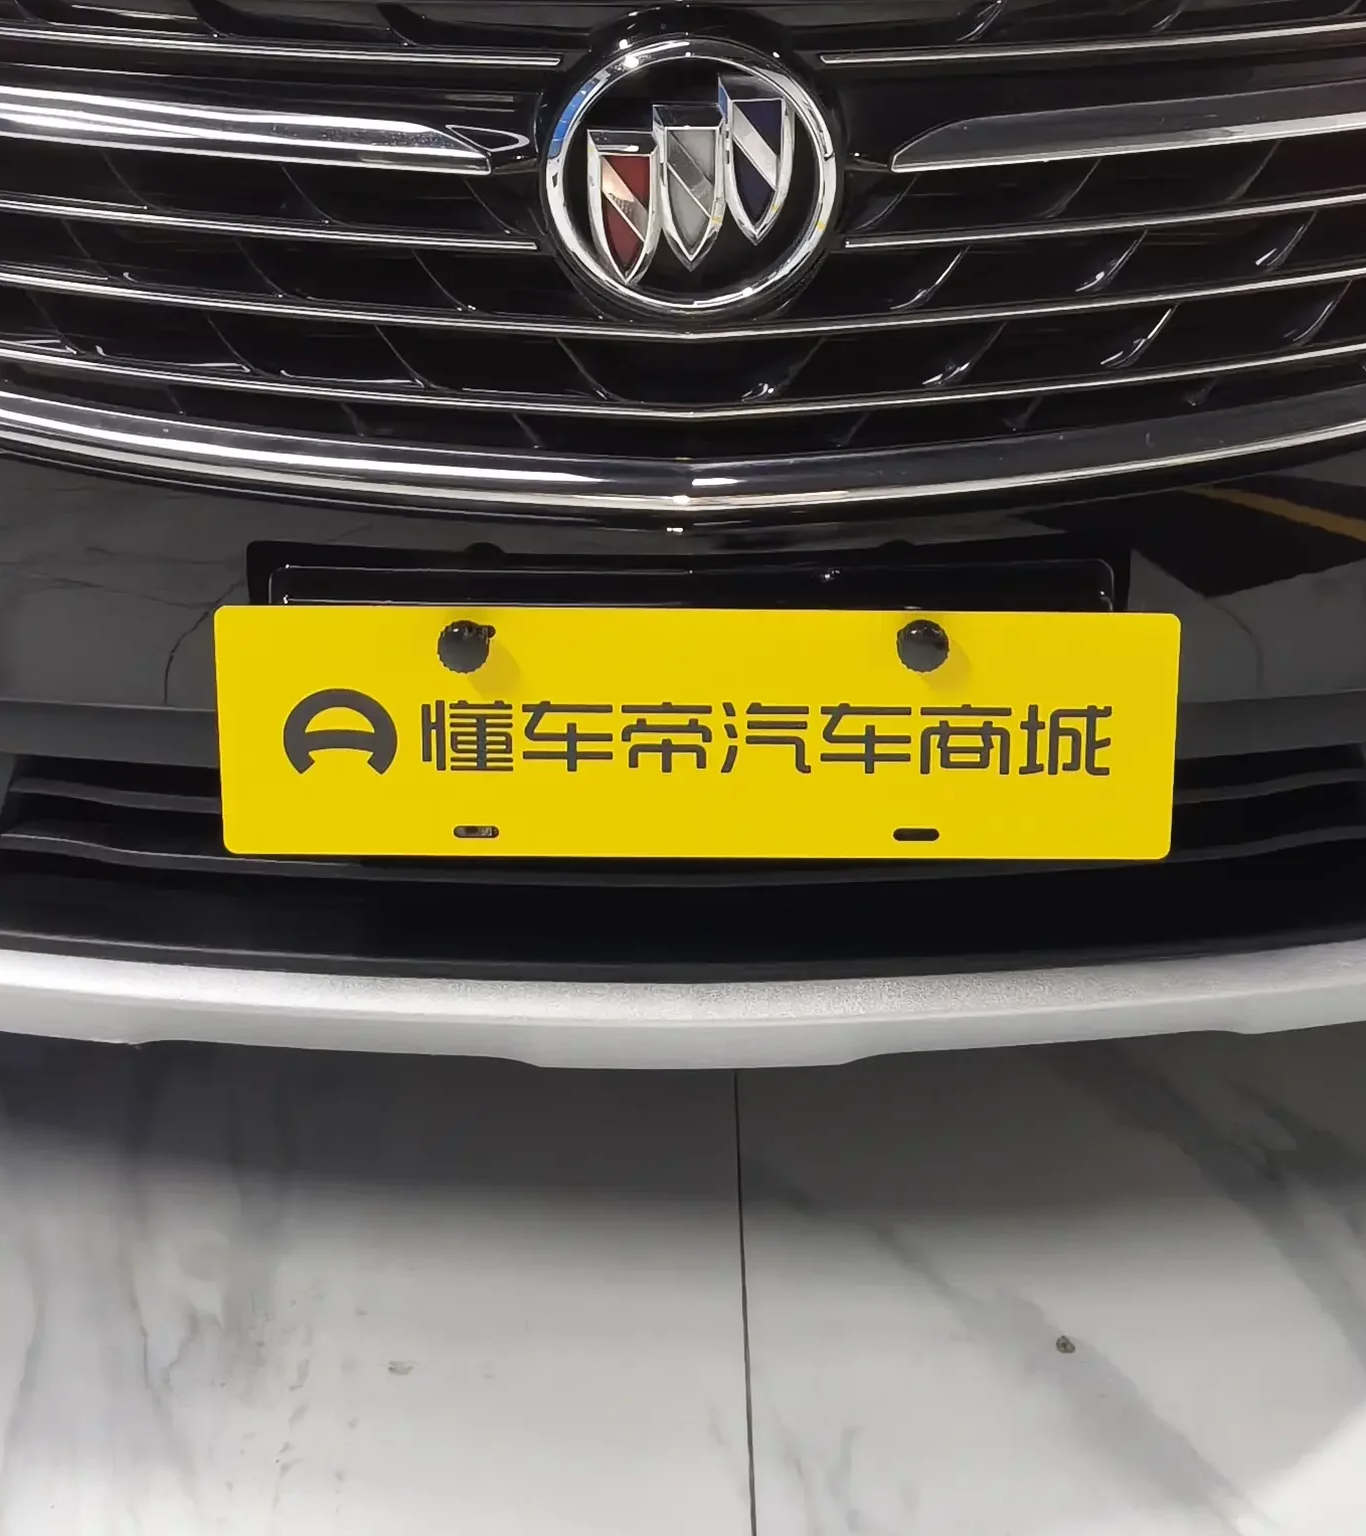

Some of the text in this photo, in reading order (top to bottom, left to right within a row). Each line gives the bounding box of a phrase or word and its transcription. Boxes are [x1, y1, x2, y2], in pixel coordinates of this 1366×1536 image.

[420, 700, 1113, 777] 懂车帝汽车商城
